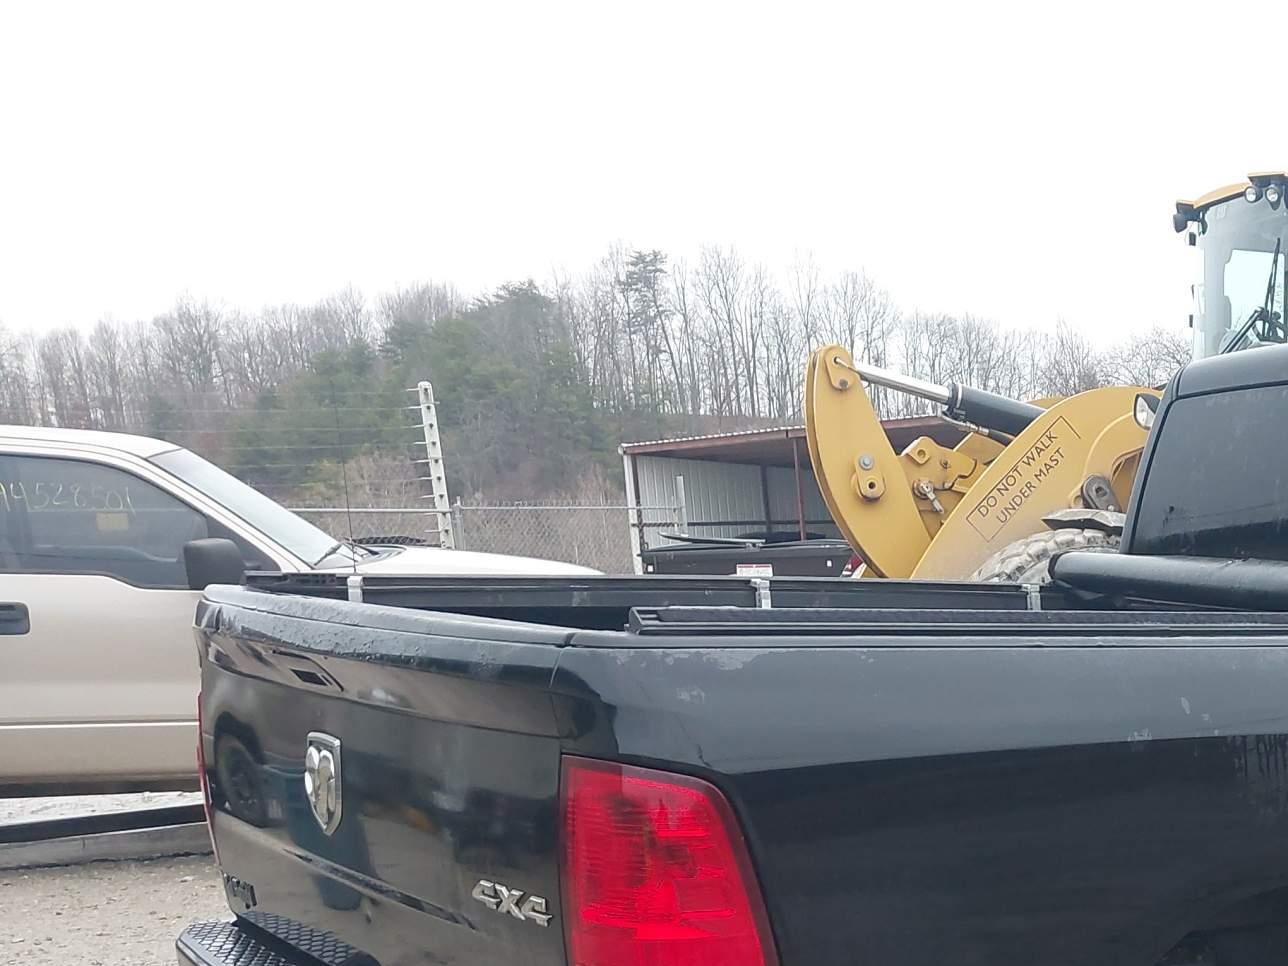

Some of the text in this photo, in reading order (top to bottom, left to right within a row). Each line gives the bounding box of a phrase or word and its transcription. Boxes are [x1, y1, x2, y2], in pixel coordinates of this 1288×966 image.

[977, 430, 1058, 518] DO NOT WALK
[996, 447, 1065, 524] UNDER MAST
